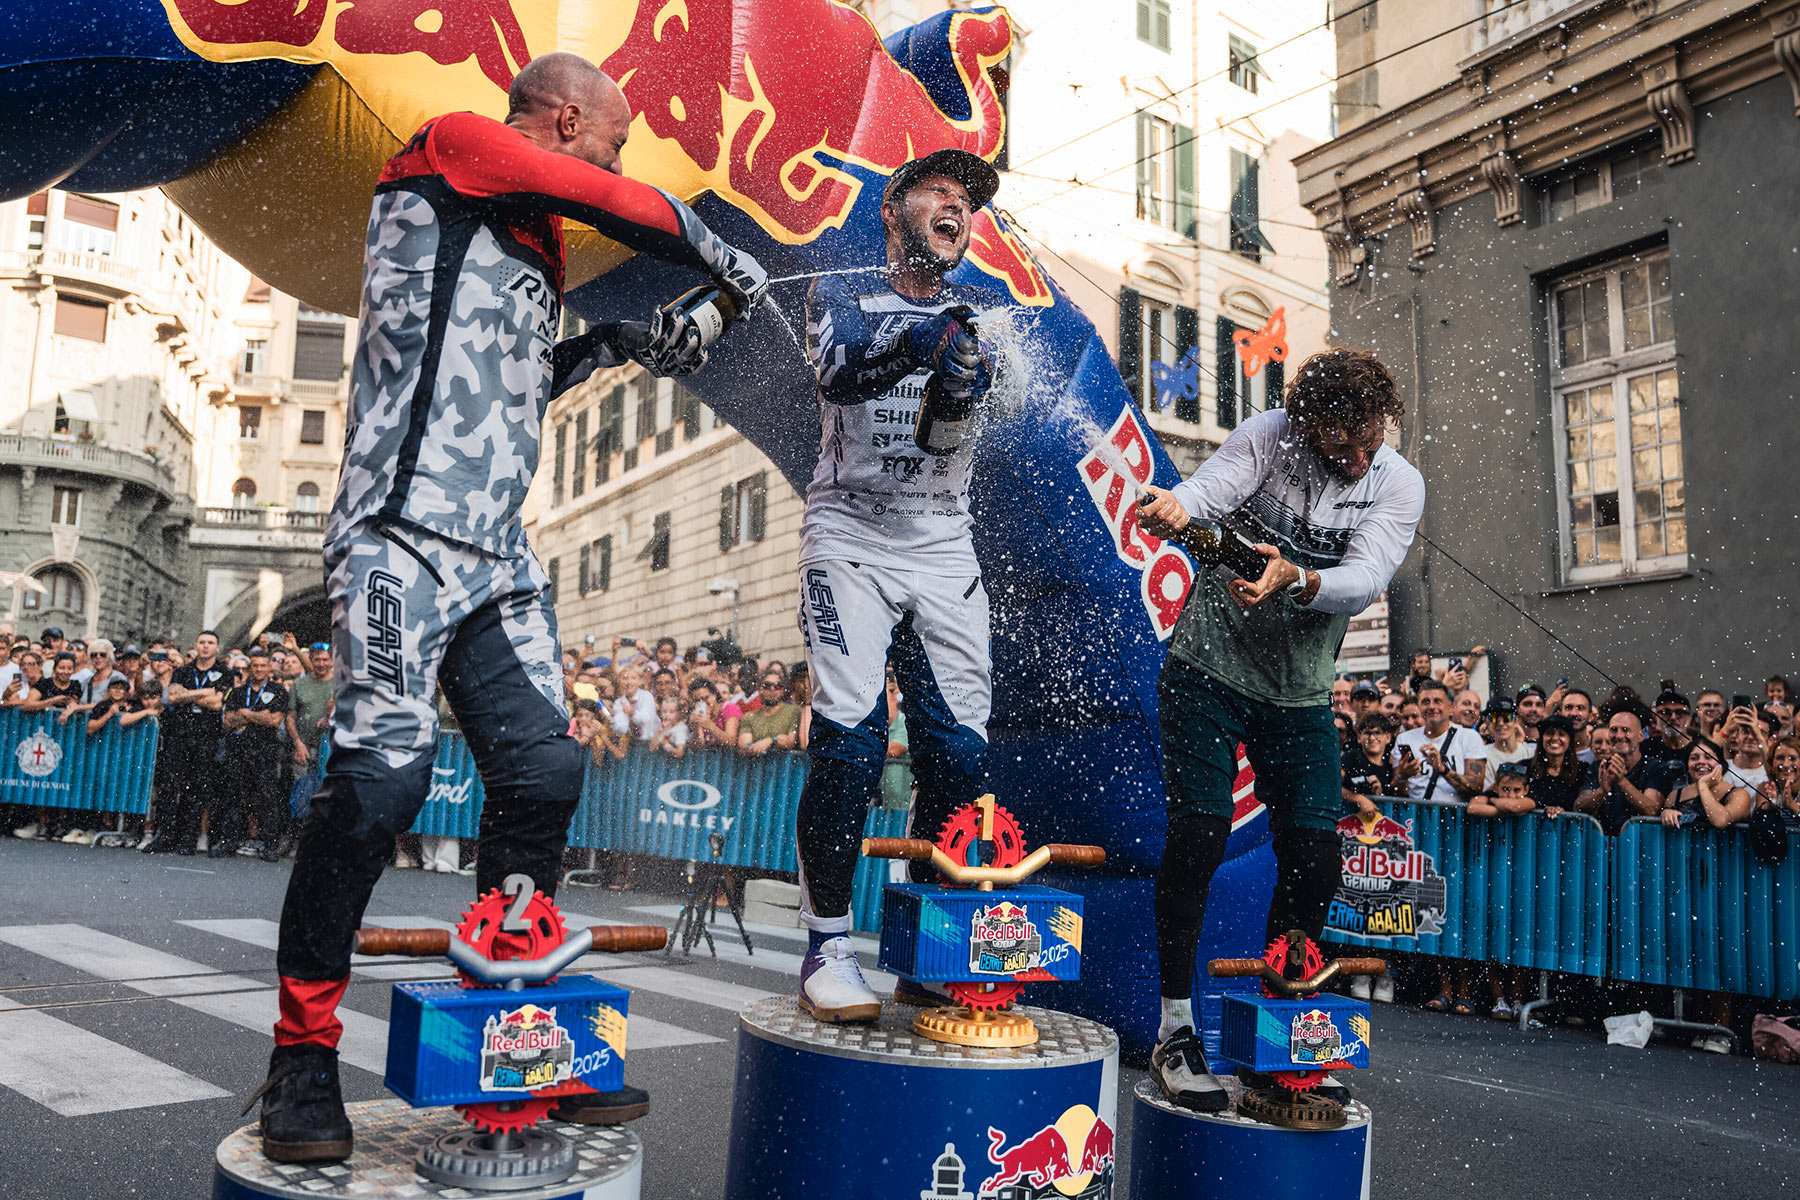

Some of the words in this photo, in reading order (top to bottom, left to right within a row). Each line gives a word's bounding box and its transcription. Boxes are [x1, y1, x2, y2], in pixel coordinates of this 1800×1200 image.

[881, 455, 925, 483] FOX
[41, 781, 71, 791] GENOVA
[425, 766, 472, 804] ord
[640, 808, 735, 830] OAKLEY
[973, 793, 995, 841] 1
[1370, 849, 1423, 881] Bull
[500, 873, 535, 931] 2
[1327, 899, 1364, 931] ERRO
[1367, 904, 1413, 934] ABAJO
[978, 924, 1004, 941] Red
[1006, 924, 1031, 940] Bull
[1040, 942, 1072, 967] 2025
[1286, 929, 1307, 966] 3
[1004, 951, 1026, 971] ABAJO
[492, 1032, 525, 1051] Red
[528, 1029, 560, 1049] Bull
[1296, 1026, 1315, 1039] Red
[1316, 1025, 1334, 1038] Bull
[573, 1047, 611, 1077] 2025
[1340, 1039, 1362, 1060] 2025
